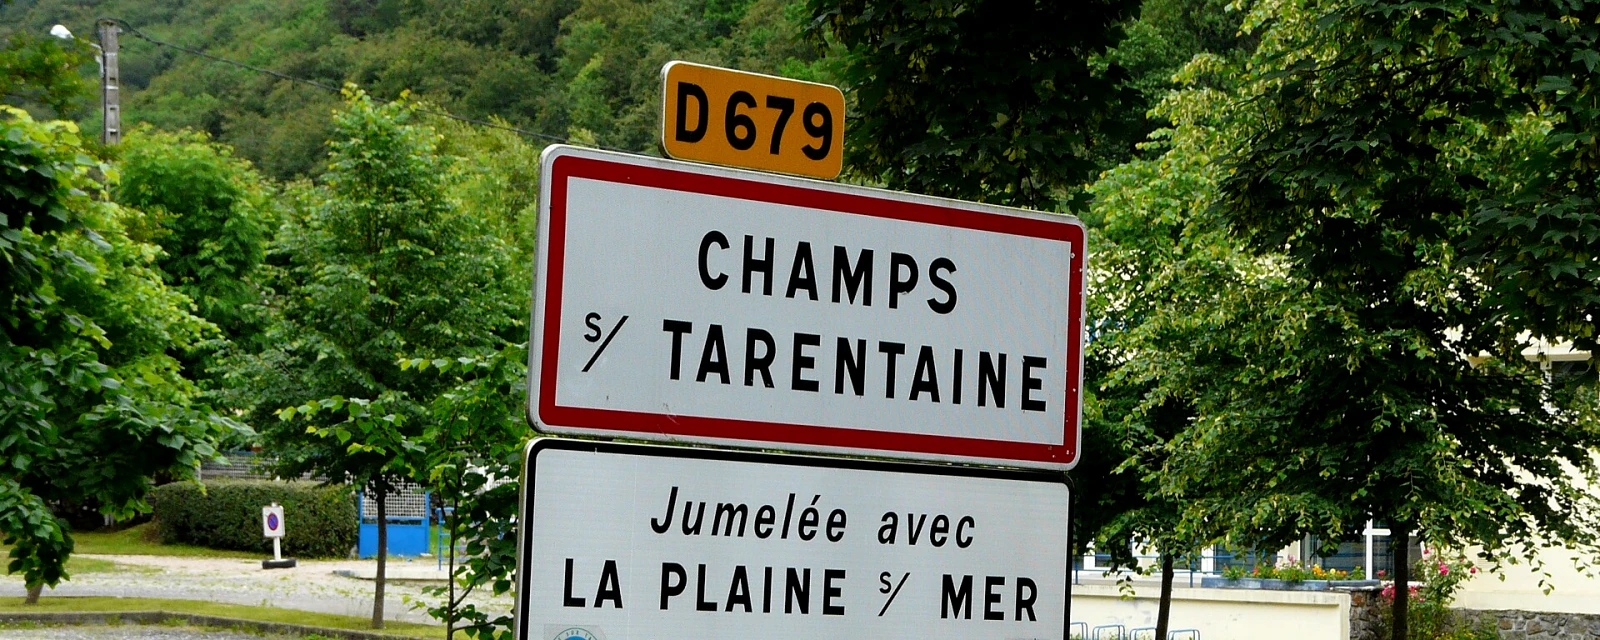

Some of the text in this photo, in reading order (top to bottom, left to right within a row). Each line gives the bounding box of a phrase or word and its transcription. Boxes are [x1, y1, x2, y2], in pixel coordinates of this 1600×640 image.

[698, 230, 959, 315] CHAMPS
[662, 318, 1048, 413] TARENTAINE
[650, 486, 976, 549] Jumelée avec
[563, 558, 623, 609] LA
[659, 562, 846, 616] PLAINE
[940, 573, 1038, 622] MER
